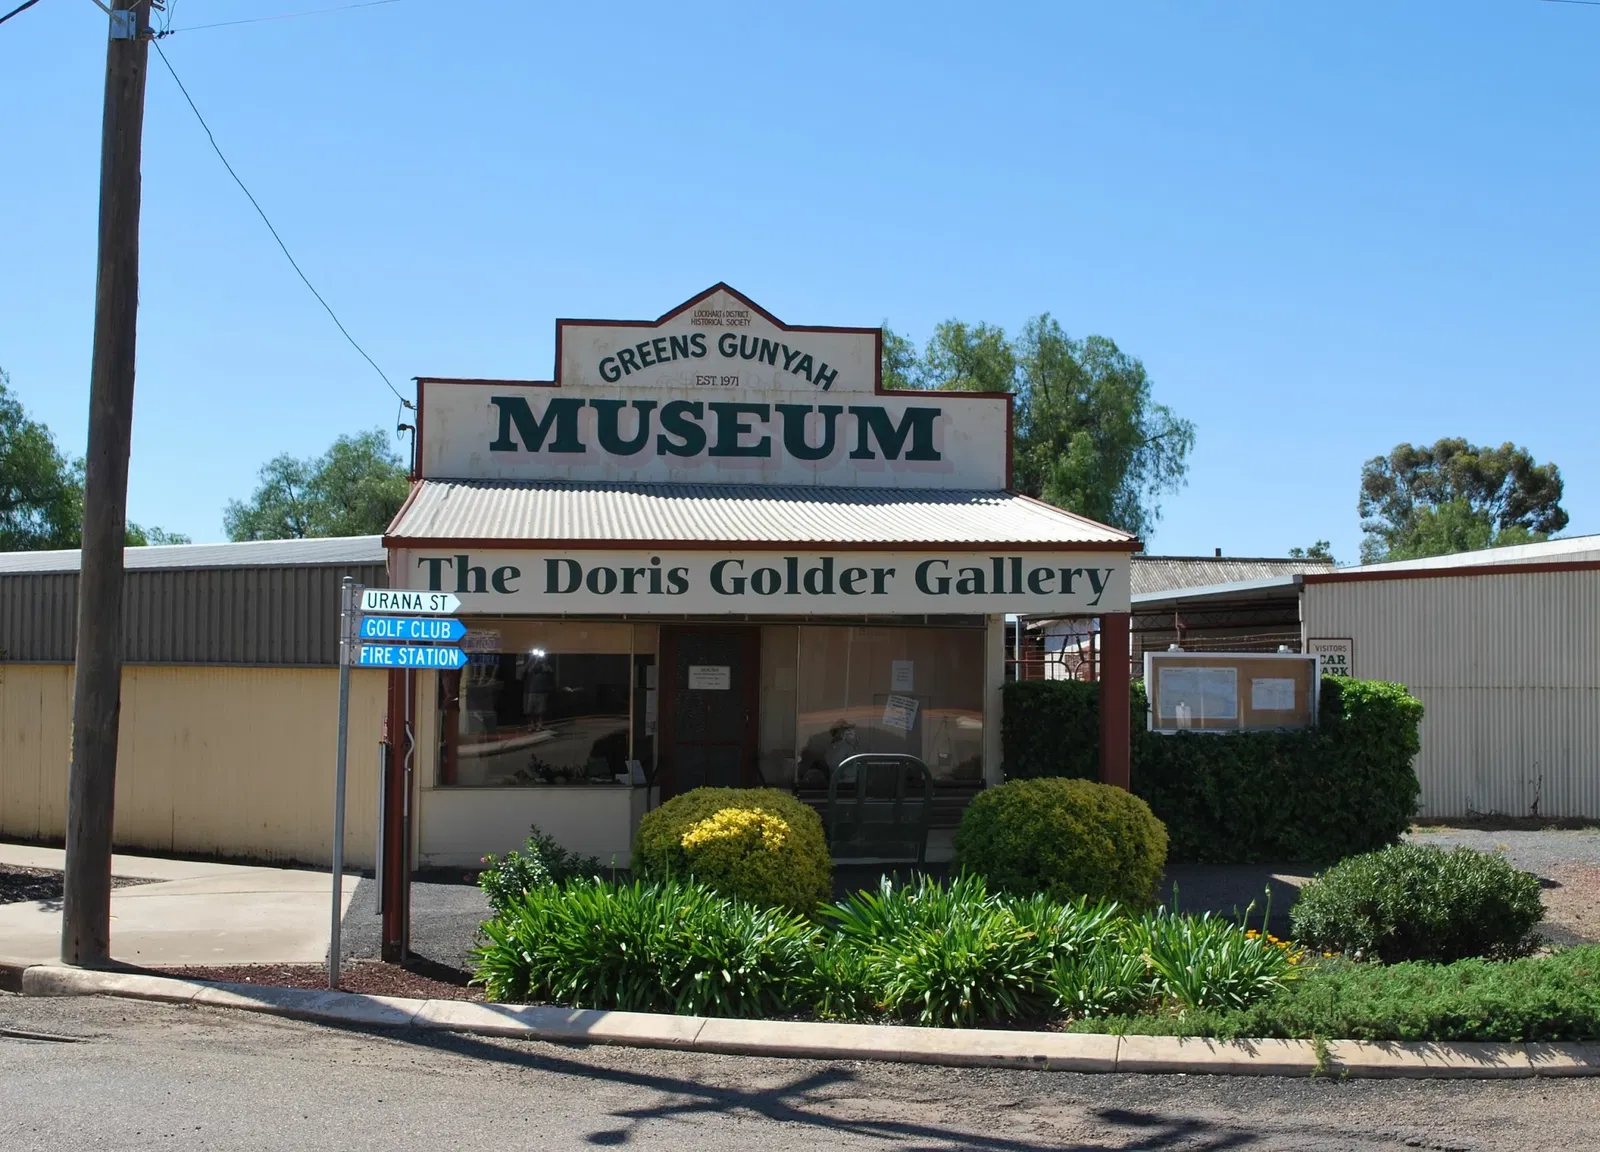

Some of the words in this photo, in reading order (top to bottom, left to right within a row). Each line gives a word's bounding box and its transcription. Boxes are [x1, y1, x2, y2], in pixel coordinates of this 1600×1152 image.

[691, 318, 724, 326] HISTORICAL
[726, 318, 751, 327] SOCIETY
[598, 333, 707, 383] GREENS
[718, 333, 839, 392] GUNYAH
[720, 376, 739, 387] 1971
[489, 396, 942, 462] MUSEUM
[417, 555, 521, 595] The
[543, 556, 690, 596] Doris
[709, 556, 896, 596] Golder
[914, 556, 1115, 607] Gallery
[368, 593, 423, 611] URANA
[430, 594, 448, 611] ST
[366, 619, 405, 637] GOLF
[411, 620, 451, 639] CLUB
[360, 646, 393, 664] FIRE
[398, 647, 459, 666] STATION
[1320, 655, 1346, 665] CAR
[1320, 667, 1349, 676] ARK
